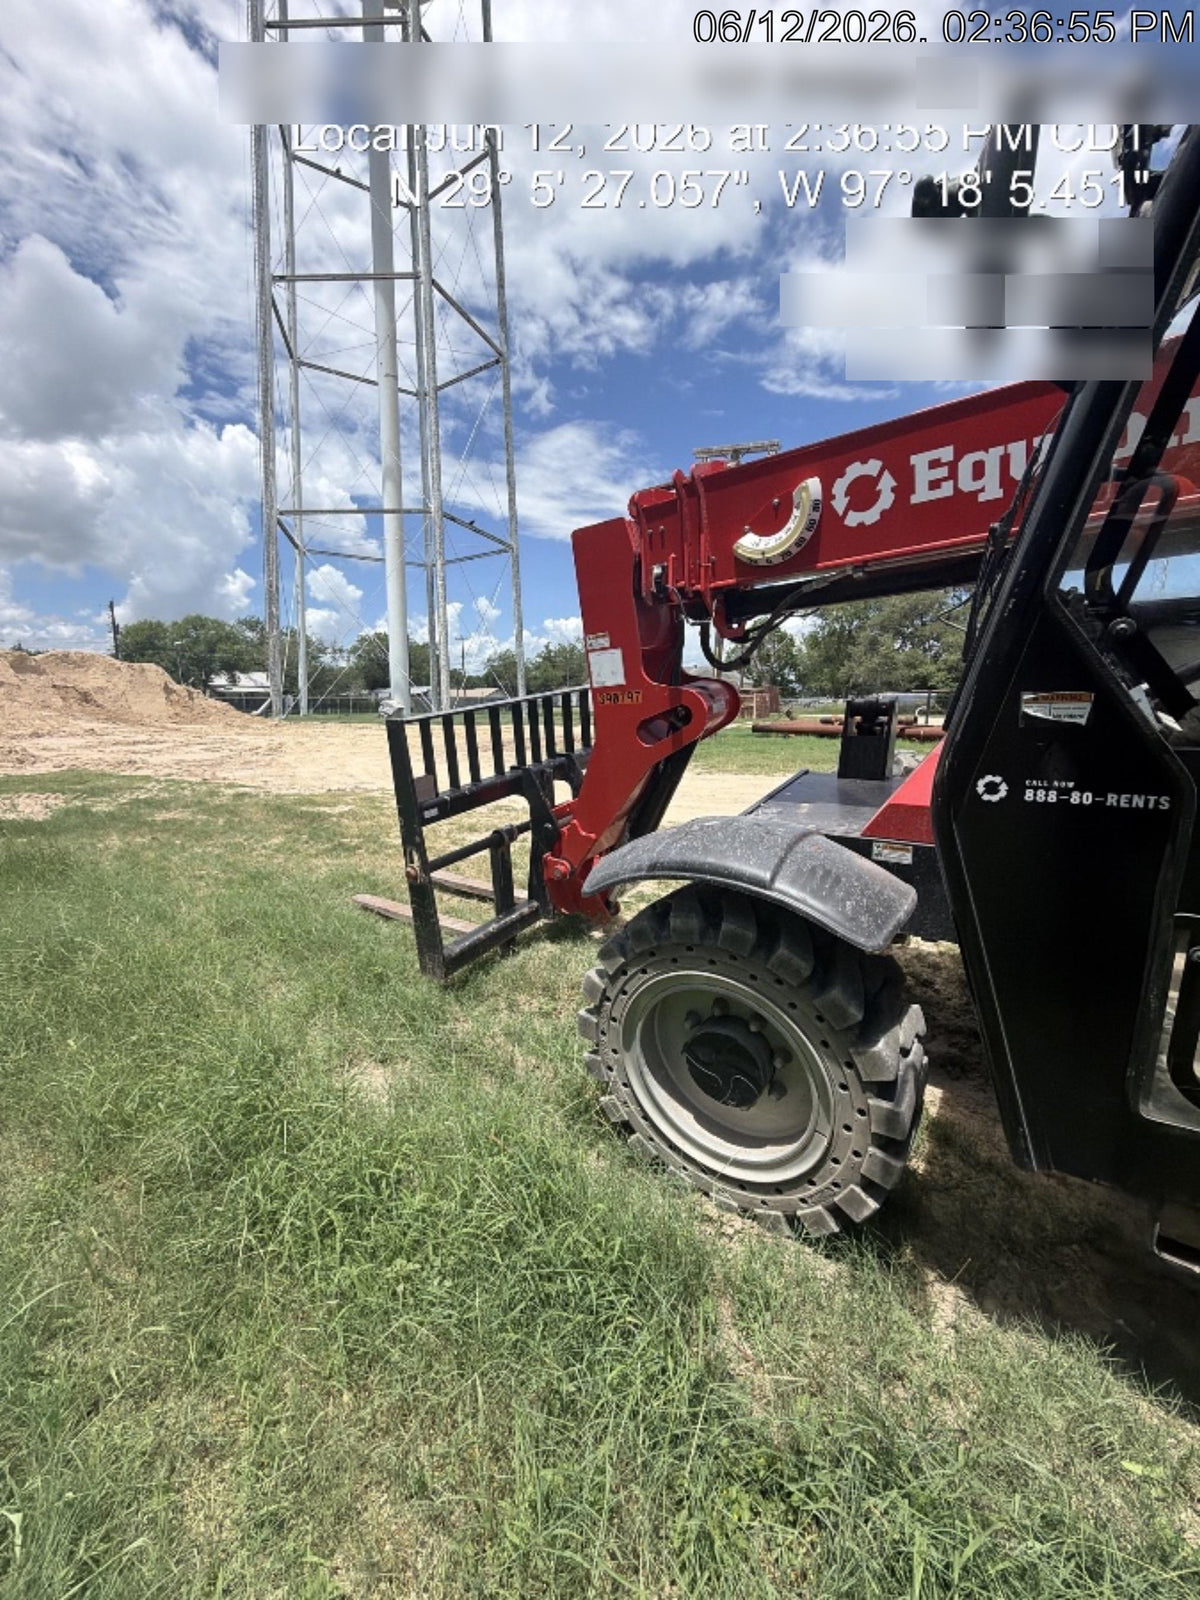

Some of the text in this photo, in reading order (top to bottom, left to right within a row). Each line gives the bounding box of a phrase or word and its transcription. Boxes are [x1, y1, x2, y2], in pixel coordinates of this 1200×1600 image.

[1025, 779, 1075, 789] CALL NOW
[1024, 788, 1171, 810] 888-80-RENTS
